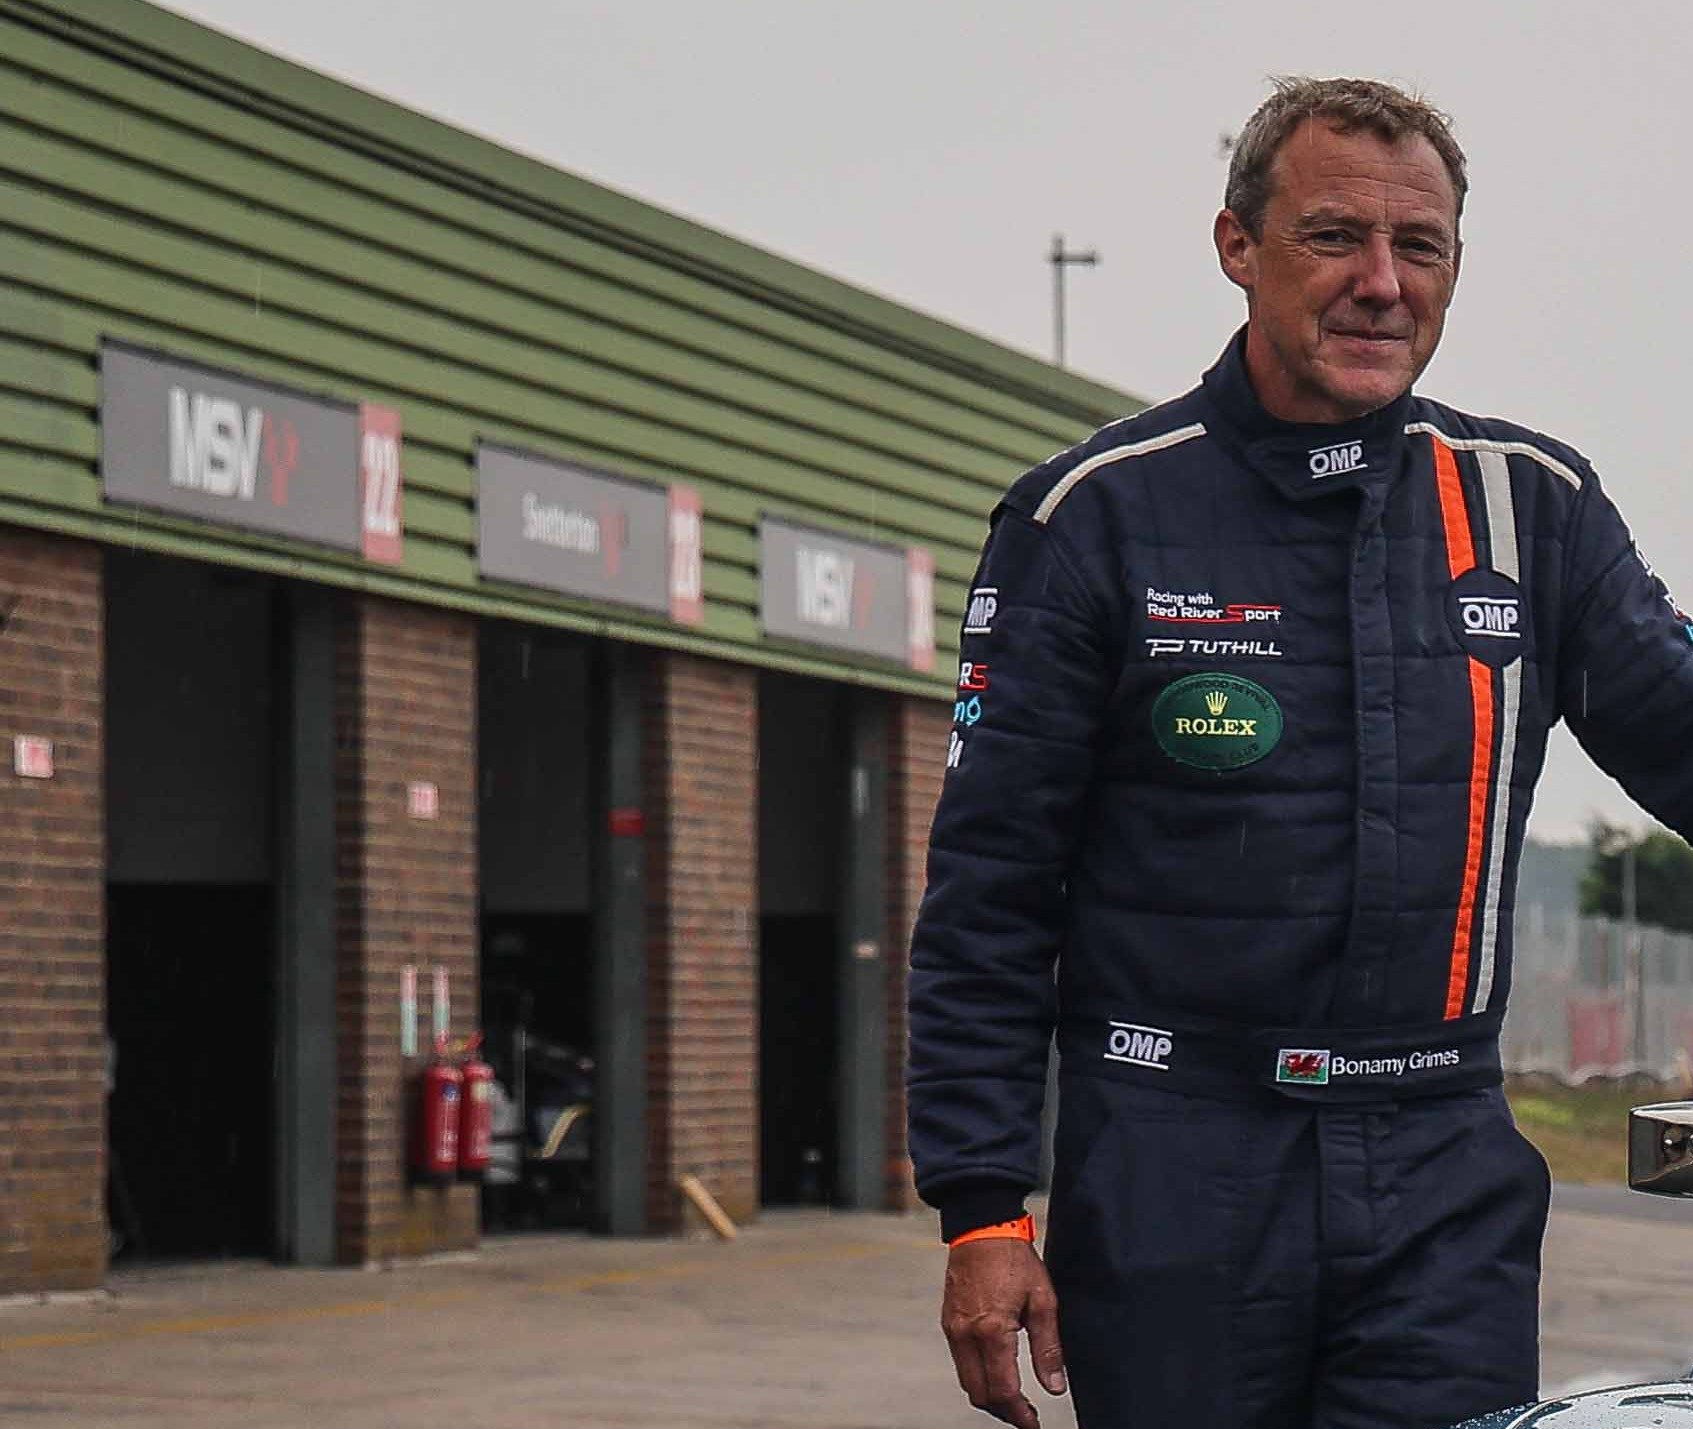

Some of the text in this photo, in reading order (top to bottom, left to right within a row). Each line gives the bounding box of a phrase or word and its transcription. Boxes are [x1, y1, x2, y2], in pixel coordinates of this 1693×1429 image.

[167, 385, 264, 500] MSV
[1308, 444, 1363, 475] OMP
[1147, 587, 1213, 606] Racing with
[966, 596, 998, 627] MP
[1148, 603, 1282, 623] Red River Sport
[1462, 603, 1520, 632] OMP
[1189, 639, 1283, 656] TUTHILL
[1175, 717, 1257, 736] ROLEX
[1110, 1030, 1173, 1063] OMP
[1331, 1048, 1460, 1077] Bonamy Grimes
